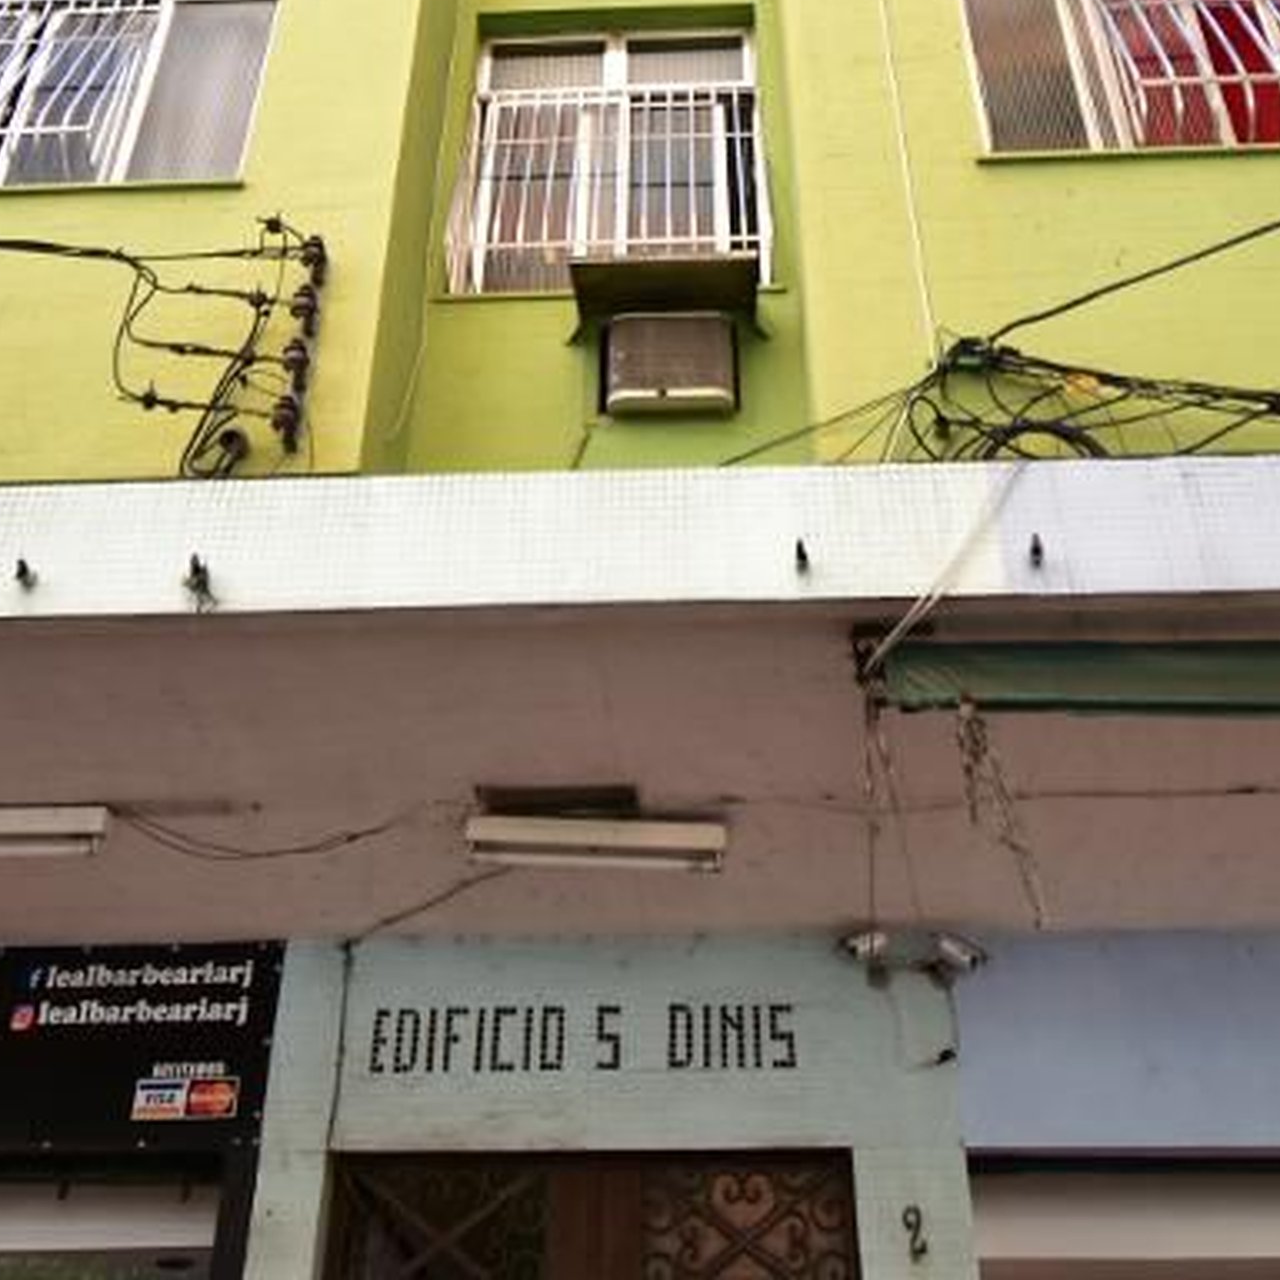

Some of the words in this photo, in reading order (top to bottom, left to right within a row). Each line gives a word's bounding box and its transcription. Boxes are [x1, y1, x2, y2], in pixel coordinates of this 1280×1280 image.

[45, 960, 254, 988] lealbarbeariarj
[37, 995, 250, 1026] lealbarbeariarj
[368, 1005, 566, 1073] EDIFICIO
[593, 1005, 624, 1070] S
[666, 1003, 798, 1070] DINIS
